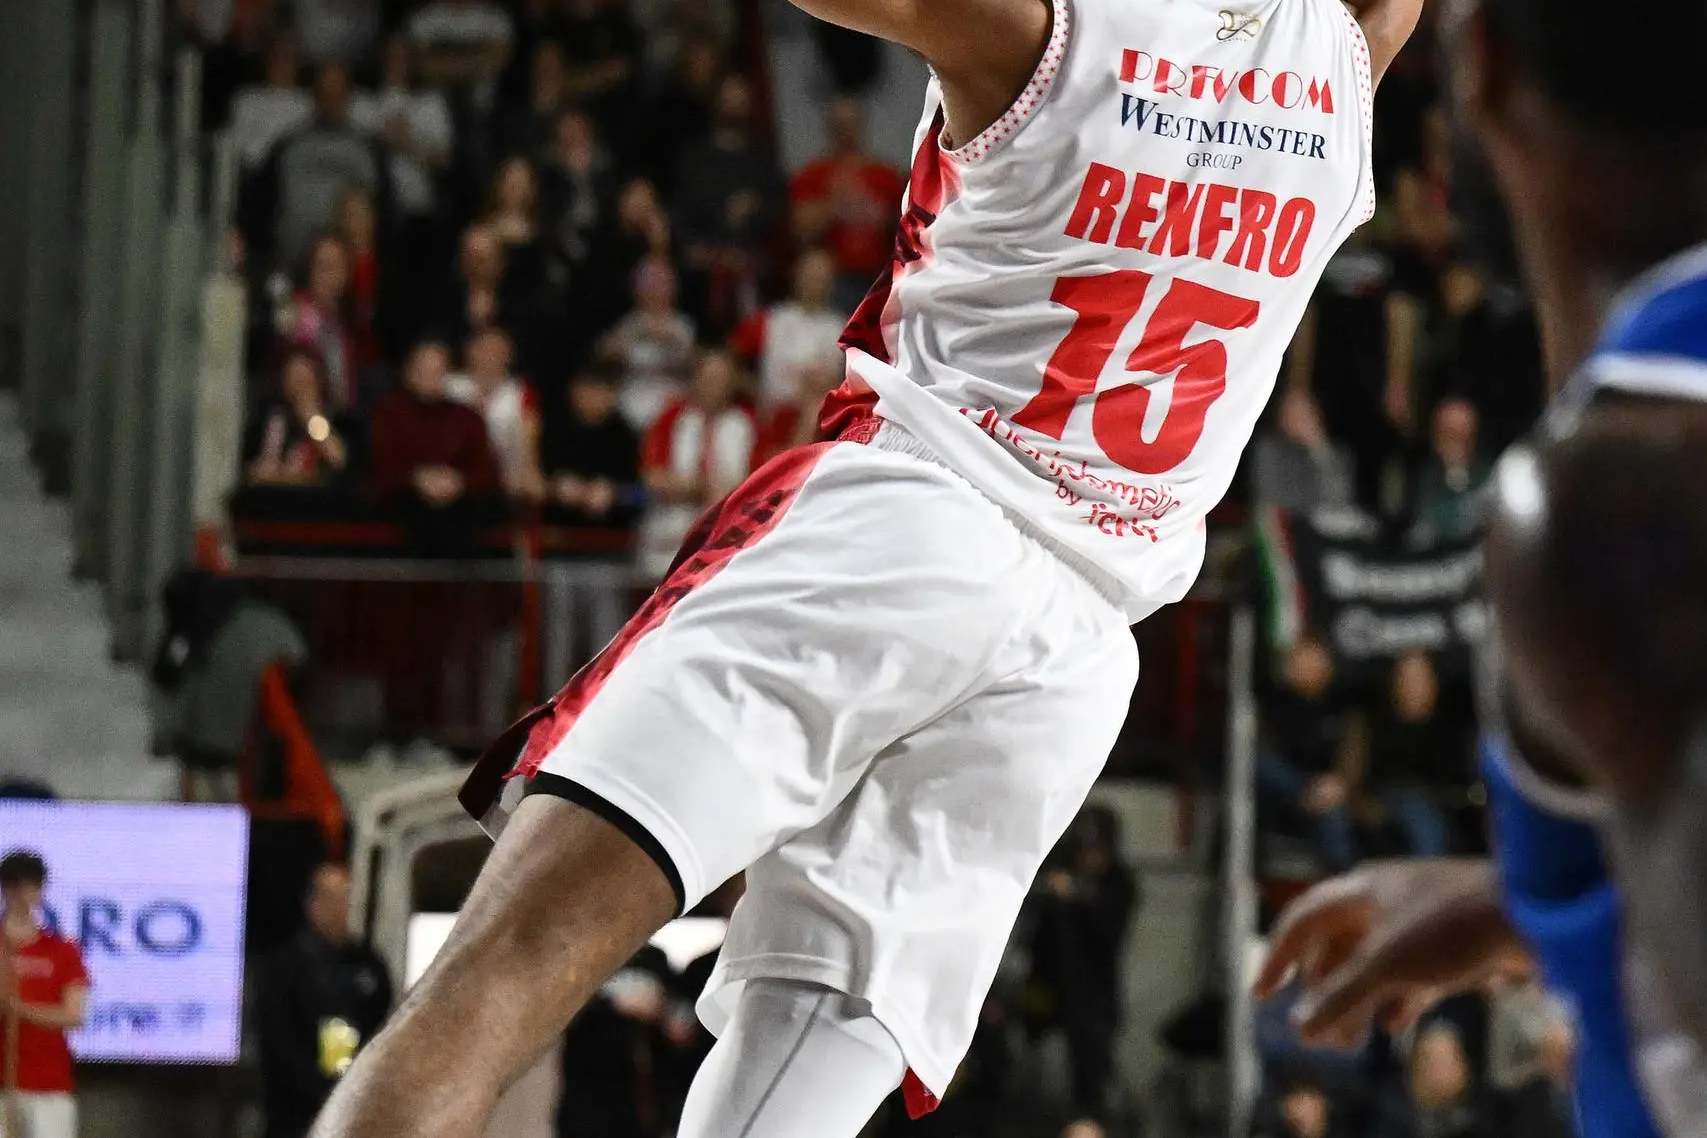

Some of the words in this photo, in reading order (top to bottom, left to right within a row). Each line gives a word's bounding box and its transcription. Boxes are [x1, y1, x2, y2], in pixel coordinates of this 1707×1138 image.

[1186, 152, 1243, 170] GROUP
[1064, 162, 1317, 278] RENFRO
[1011, 269, 1261, 475] 15
[1056, 479, 1081, 506] by
